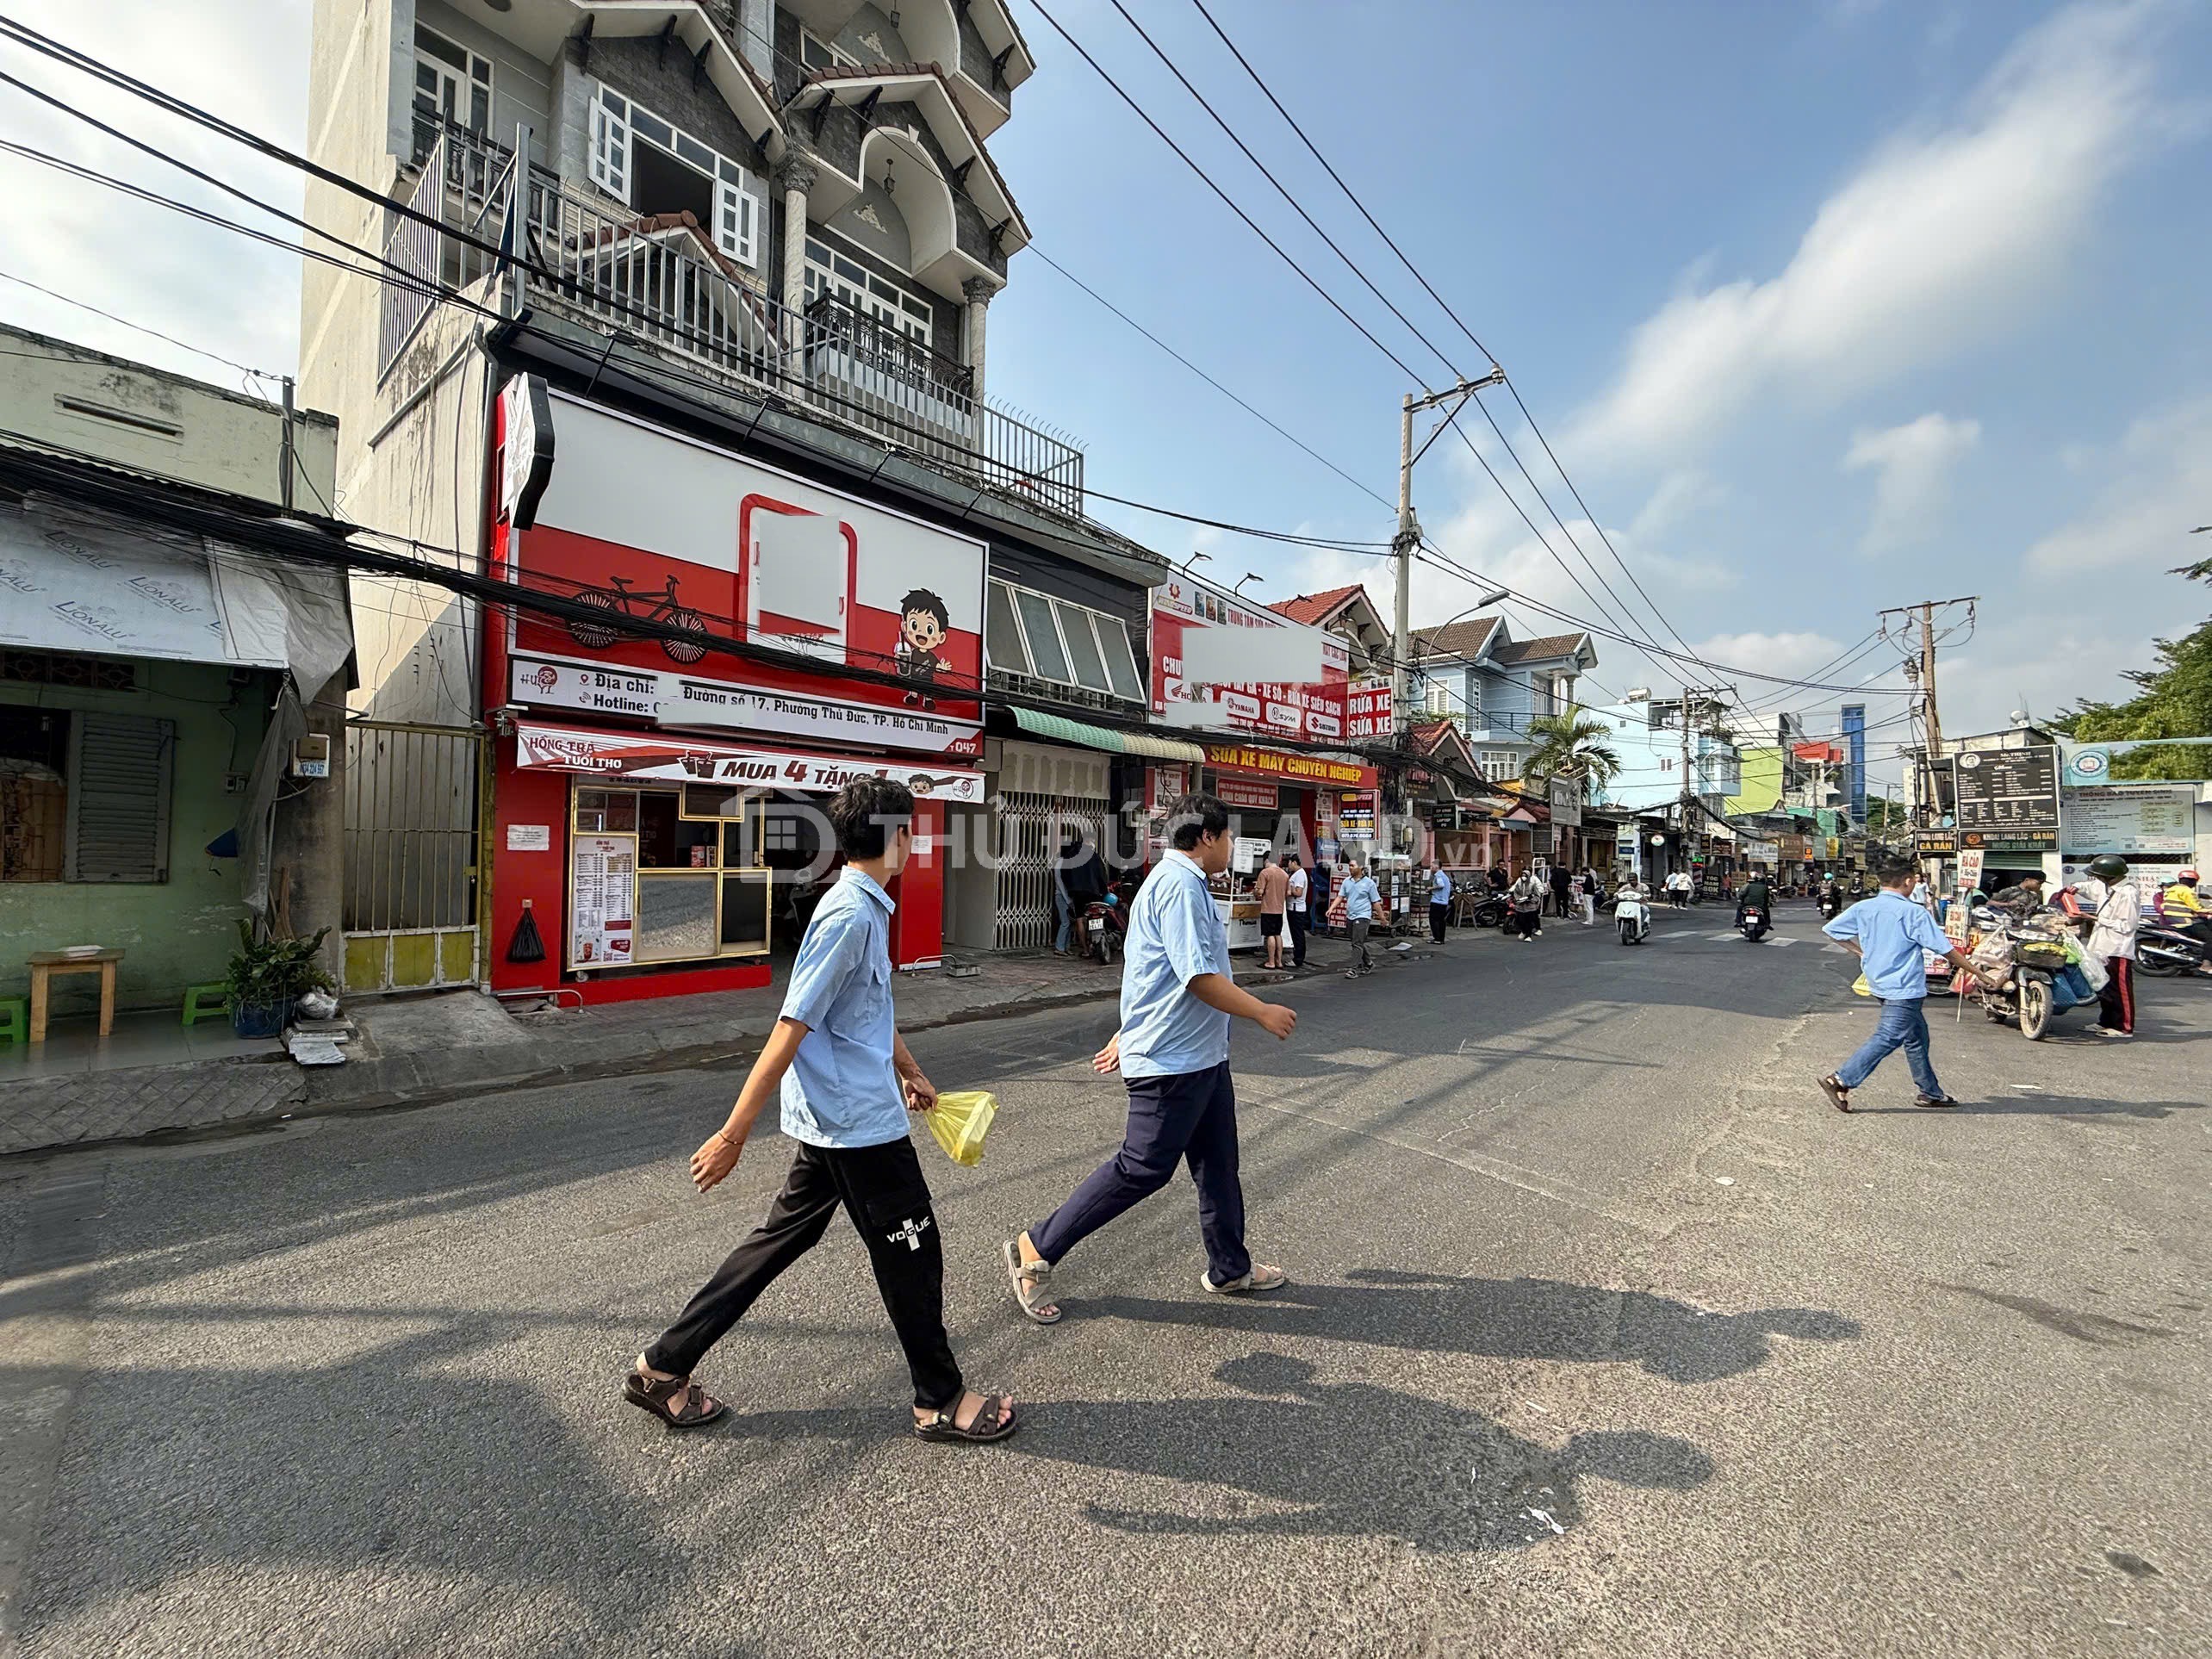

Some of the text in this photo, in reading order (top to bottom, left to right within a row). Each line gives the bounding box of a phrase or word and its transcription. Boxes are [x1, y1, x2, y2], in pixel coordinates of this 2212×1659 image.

[129, 576, 196, 613] LIONALU
[56, 600, 127, 639] LIONALU
[593, 693, 649, 713] Hotline:
[594, 673, 620, 692] Địa
[626, 677, 654, 694] chỉ:
[774, 699, 817, 719] Phường
[821, 706, 842, 721] Thủ
[846, 710, 870, 725] Đức,
[873, 714, 890, 727] TP.
[925, 720, 949, 735] Minh
[1234, 704, 1255, 714] YAMAHA
[1349, 693, 1390, 714] RỬA XE
[1279, 713, 1296, 723] SYM
[1349, 715, 1390, 736] SỬA XE
[529, 734, 595, 754] HỒNG TRÀ
[955, 742, 977, 754] 047
[563, 752, 623, 769] TUỔI THƠ
[1240, 749, 1256, 768] XE
[1258, 753, 1286, 772] MÁY
[1287, 757, 1327, 778] CHUYÊN
[1329, 765, 1363, 785] NGHIỆP
[721, 761, 778, 780] MUA
[783, 761, 808, 782] 4
[886, 1216, 931, 1243] VOGUE
